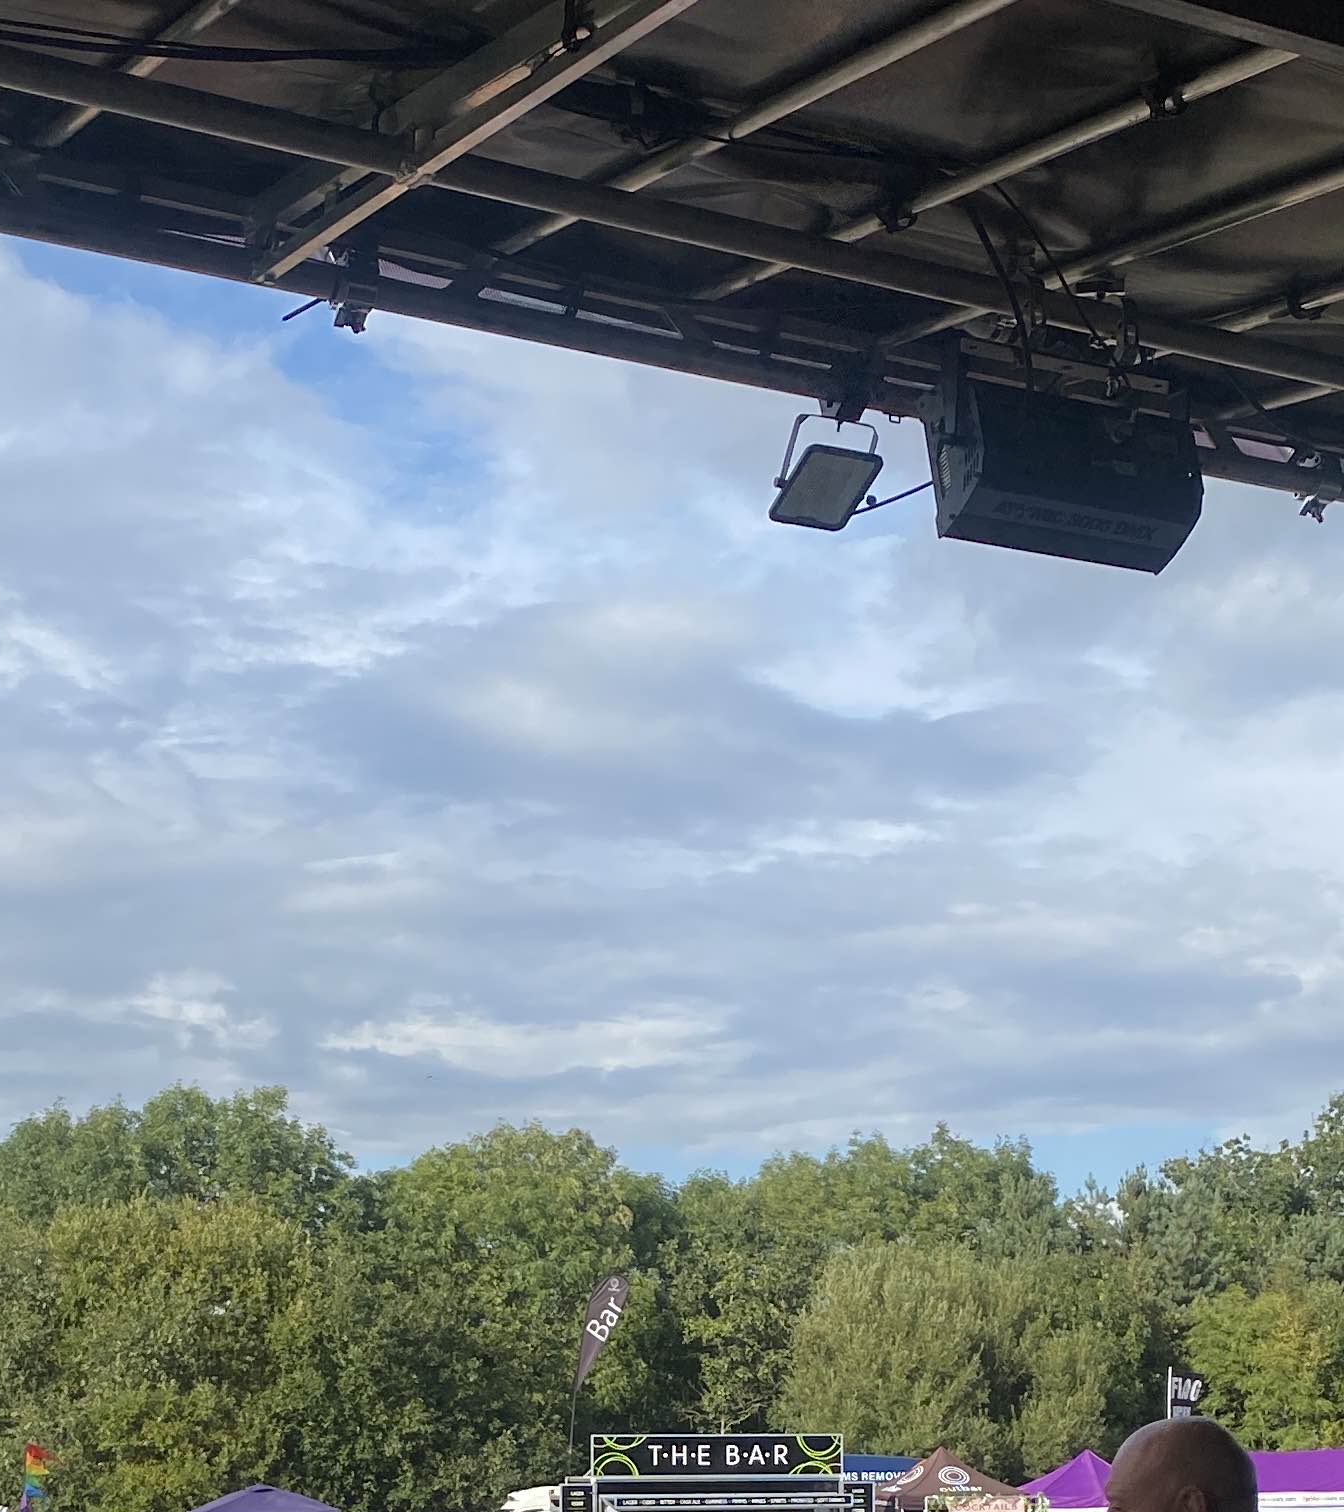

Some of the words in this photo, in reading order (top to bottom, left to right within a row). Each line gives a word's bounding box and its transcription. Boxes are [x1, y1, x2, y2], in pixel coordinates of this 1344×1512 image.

[585, 1296, 622, 1343] Bar
[861, 1471, 906, 1482] REMOV
[955, 1501, 1018, 1512] COCKTAILS
